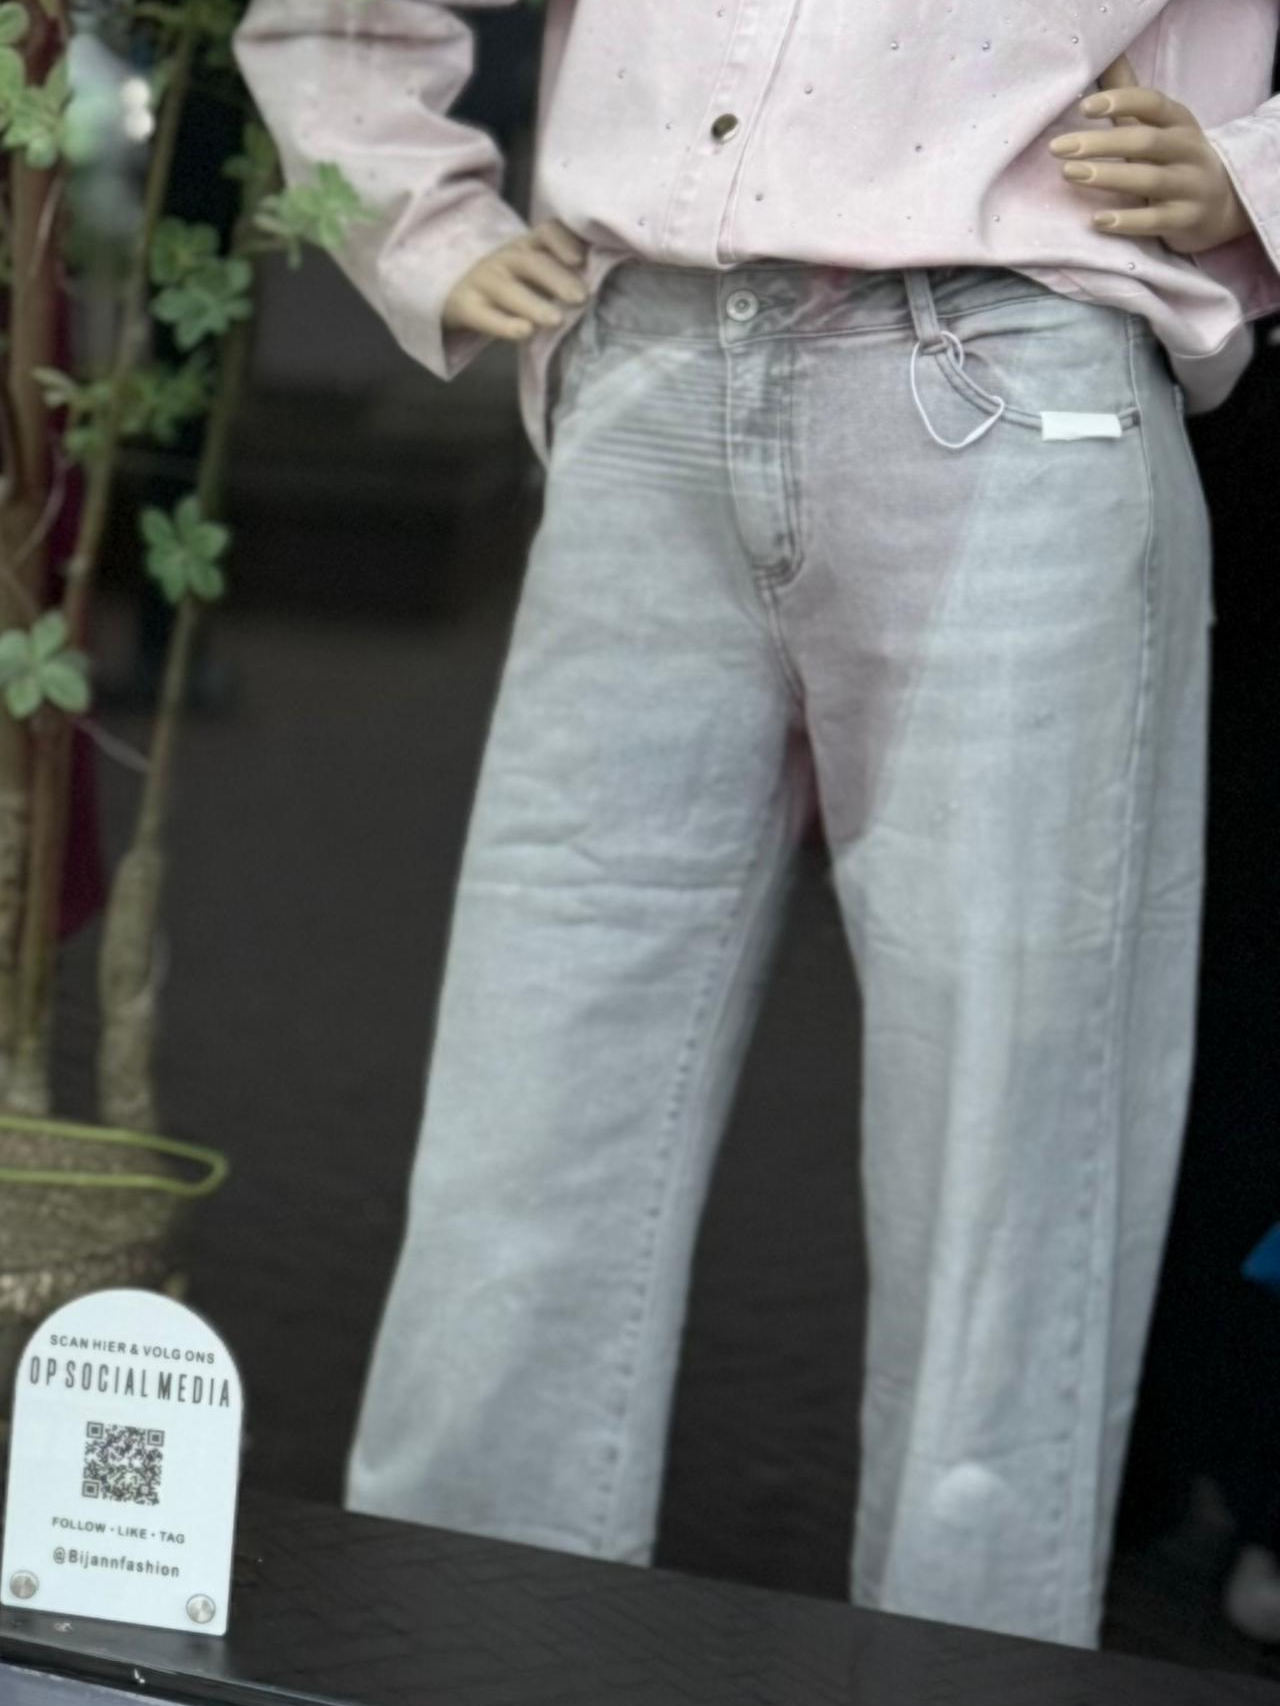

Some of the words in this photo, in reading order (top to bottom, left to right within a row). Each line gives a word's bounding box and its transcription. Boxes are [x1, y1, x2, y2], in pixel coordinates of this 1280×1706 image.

[50, 1334, 89, 1350] SCAN
[92, 1340, 126, 1353] HIER
[130, 1344, 139, 1355] &
[143, 1346, 181, 1360] VOLG
[185, 1350, 215, 1365] ONS
[29, 1355, 57, 1386] OP
[65, 1360, 148, 1398] SOCIAL
[157, 1371, 230, 1408] MEDIA
[52, 1516, 106, 1533] FOLLOW
[118, 1526, 147, 1539] LIKE
[160, 1531, 185, 1544] TAG
[53, 1546, 180, 1578] @Bijannfashion
